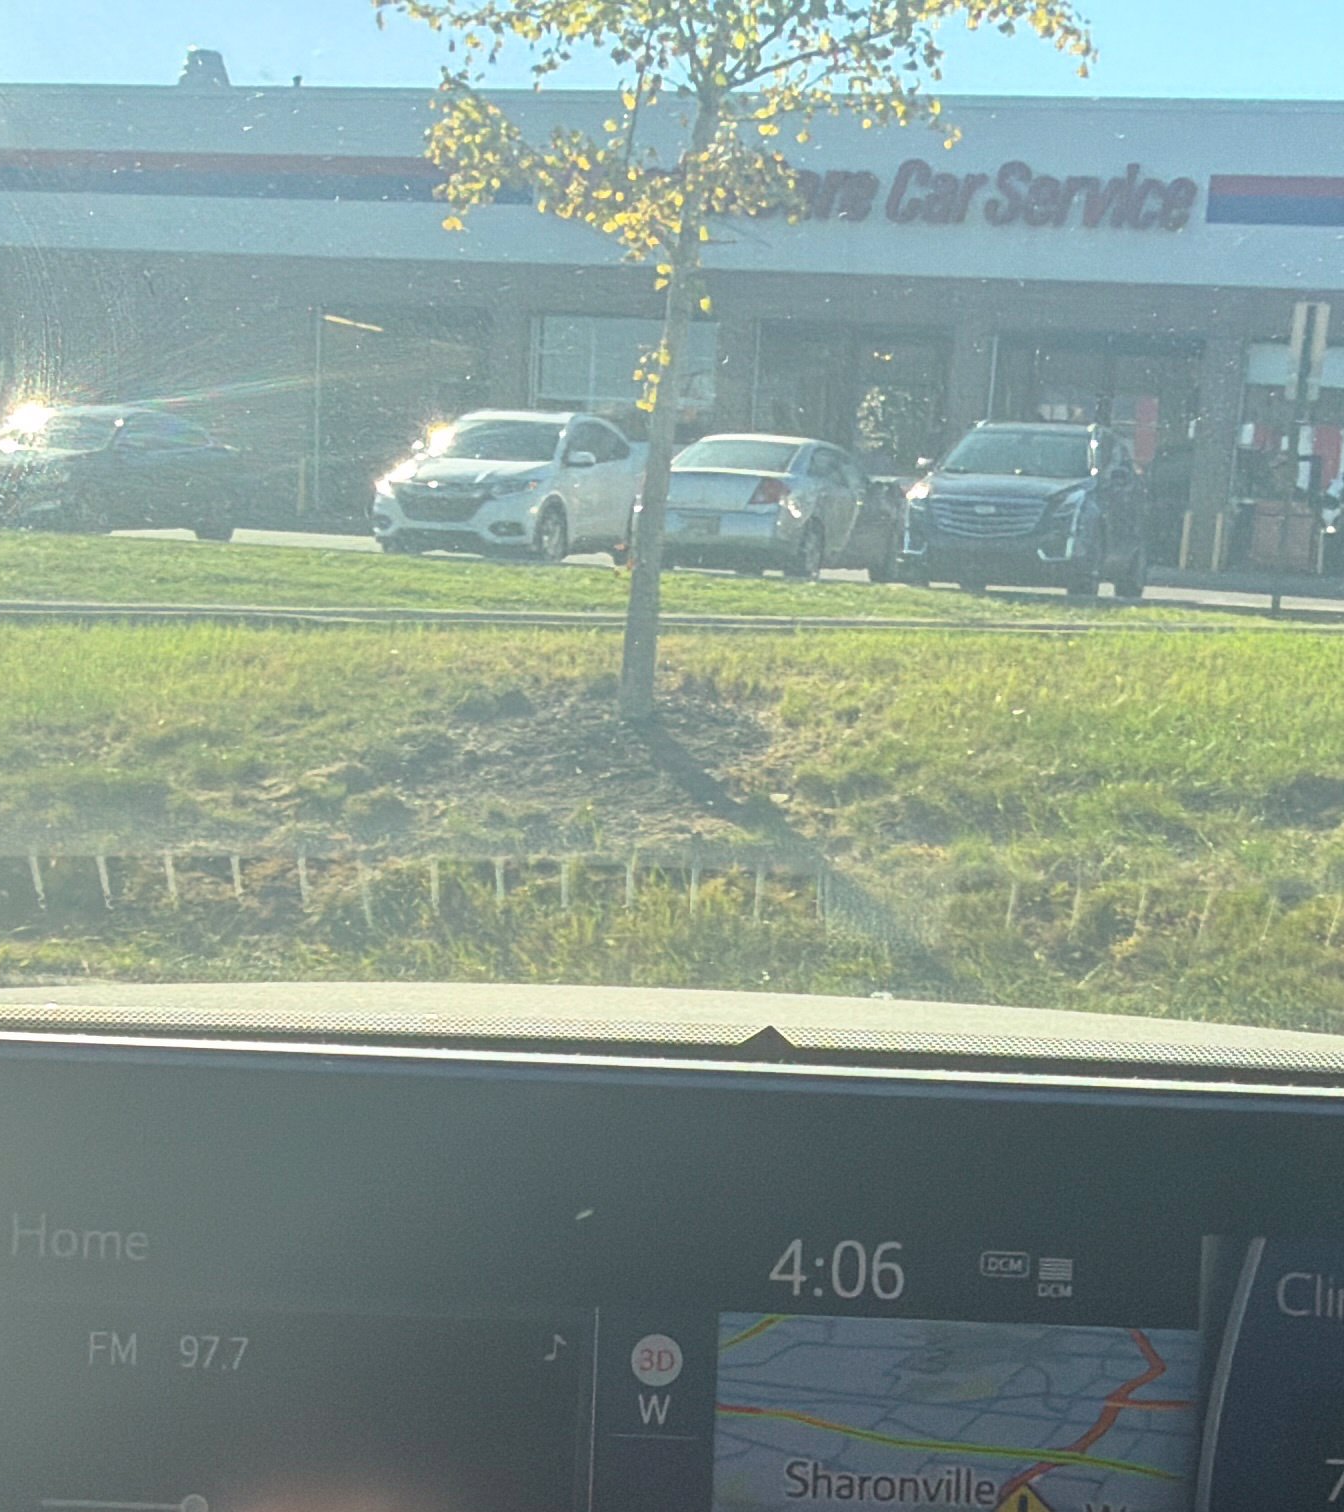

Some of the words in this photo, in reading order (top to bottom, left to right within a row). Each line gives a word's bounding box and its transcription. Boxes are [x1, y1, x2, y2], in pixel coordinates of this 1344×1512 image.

[885, 157, 987, 226] Car
[984, 160, 1198, 233] Service
[10, 1212, 150, 1262] Home
[768, 1239, 906, 1300] 4:06
[987, 1256, 1023, 1273] DCM
[1038, 1282, 1074, 1299] DCM
[87, 1330, 139, 1367] FM
[178, 1334, 251, 1372] 97.7
[637, 1347, 676, 1374] 3D
[637, 1394, 672, 1425] W
[783, 1459, 998, 1508] Sharonville
